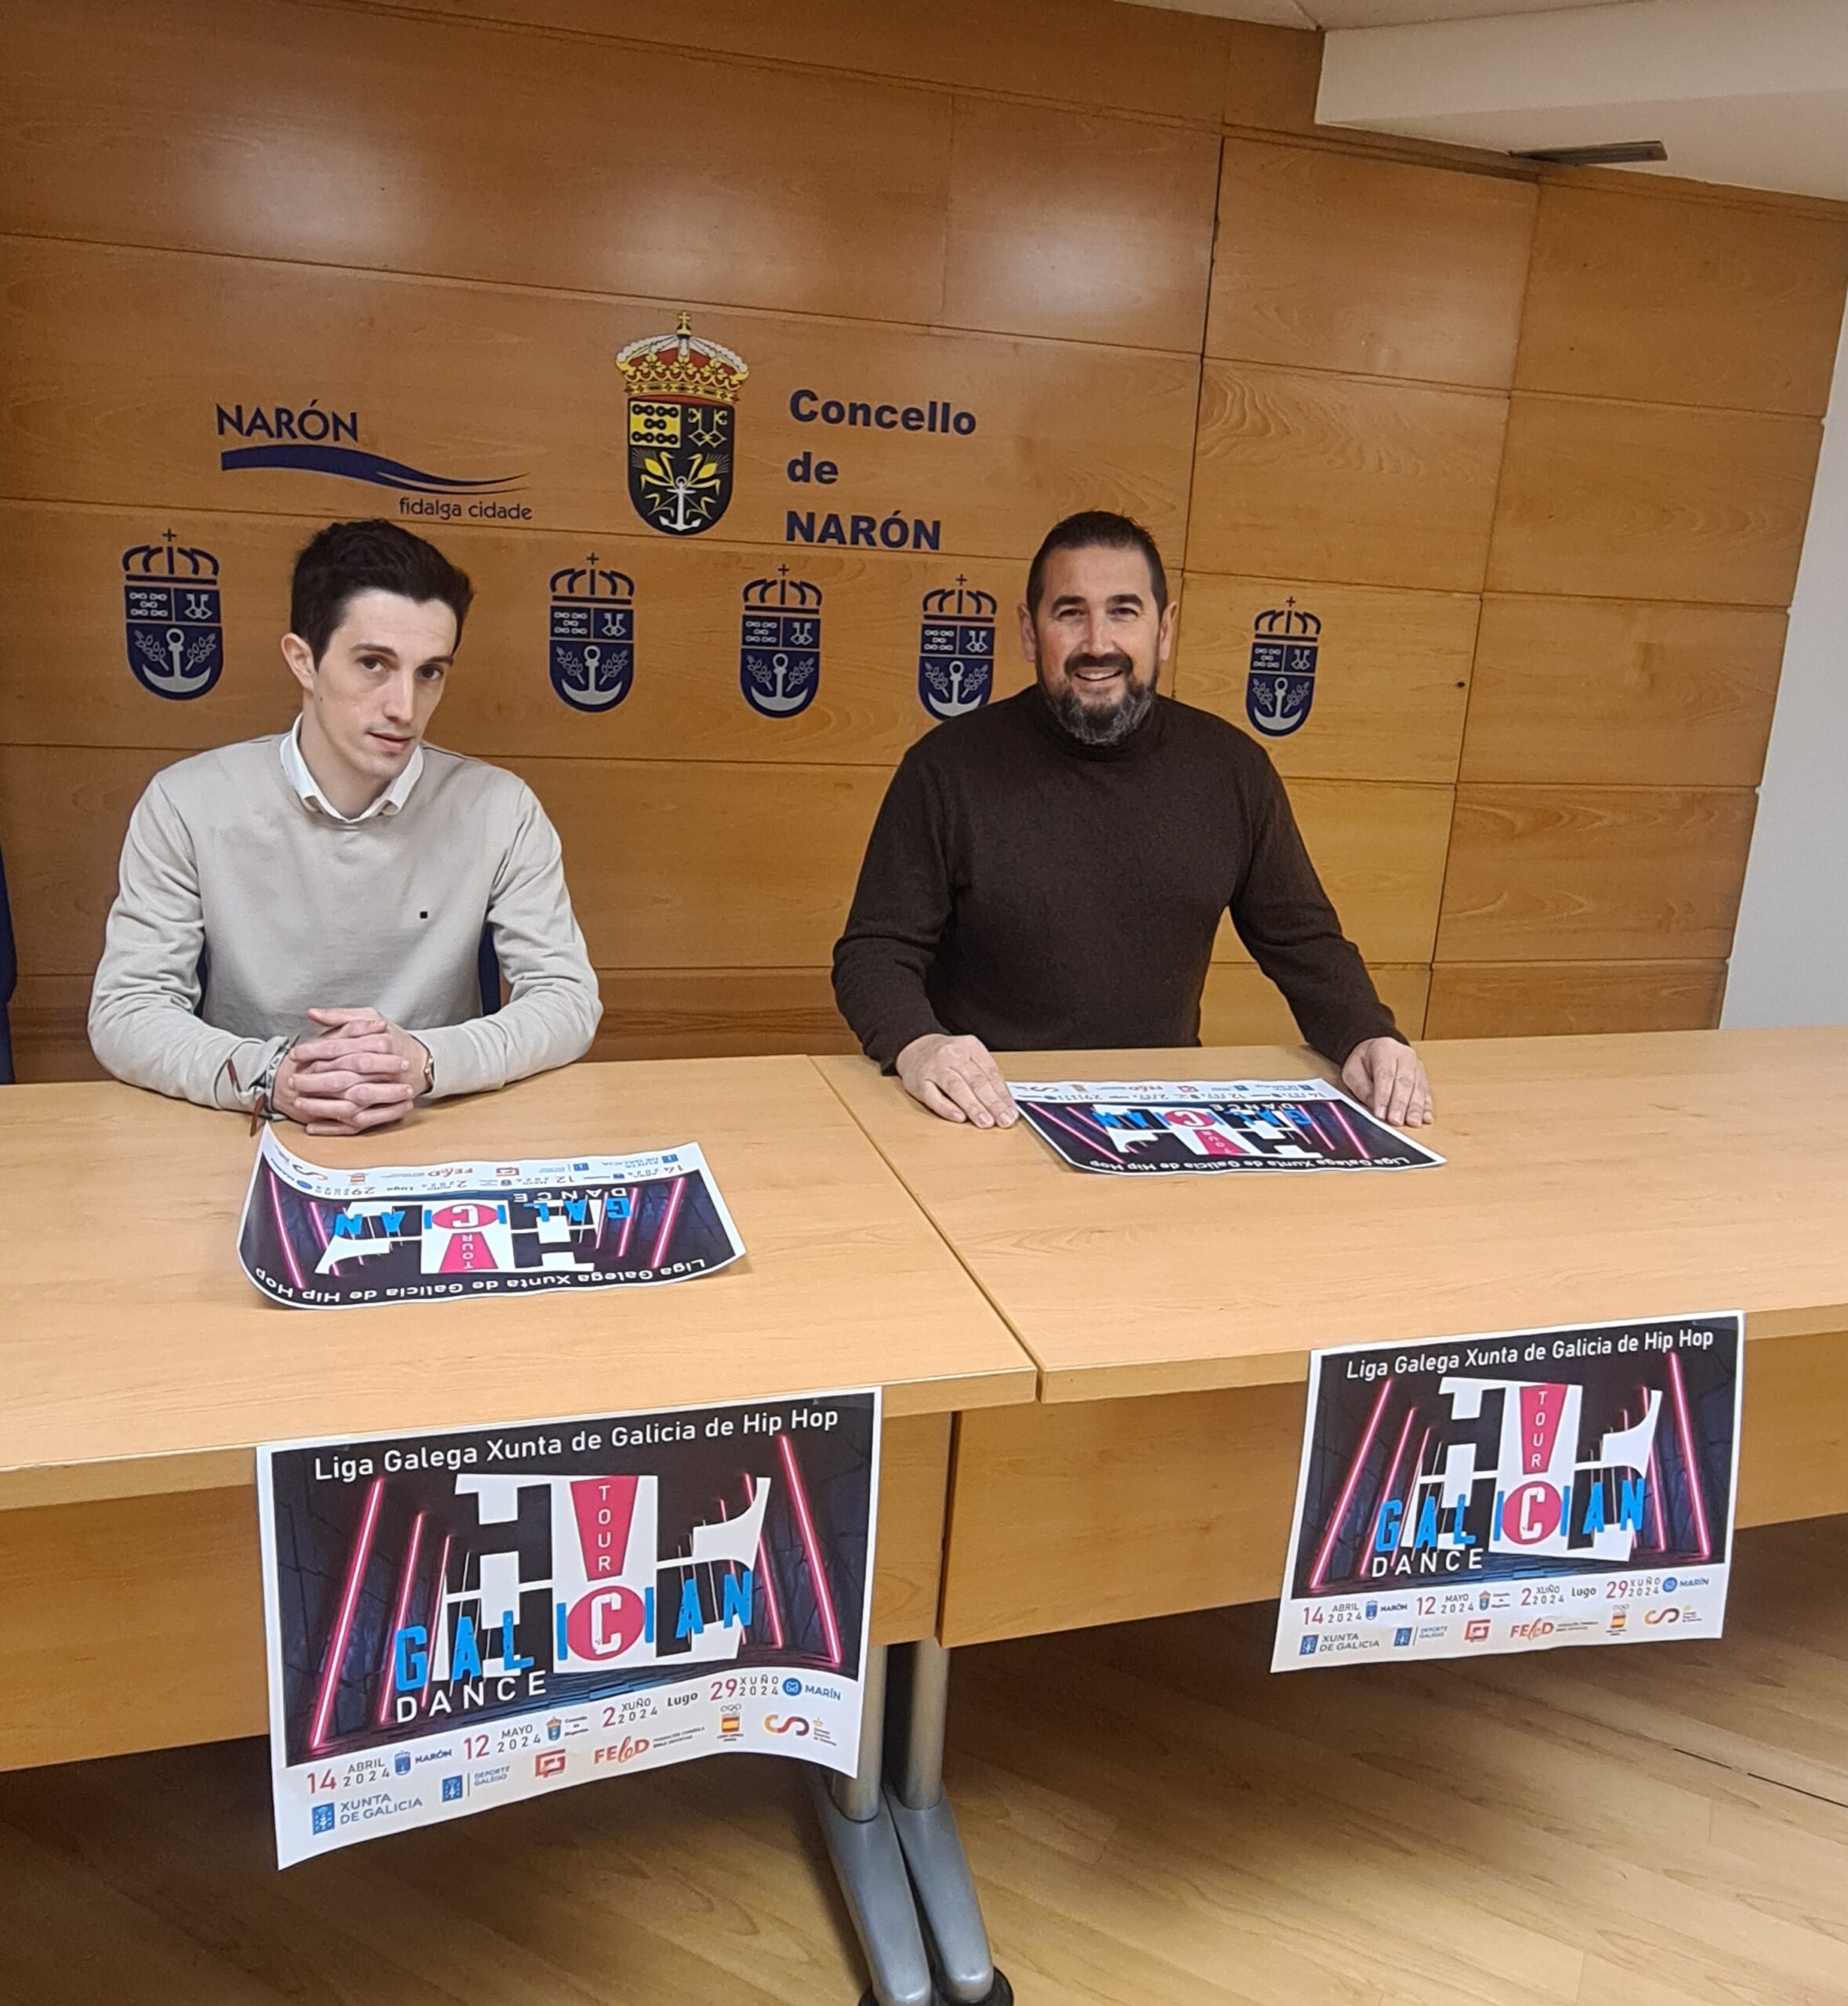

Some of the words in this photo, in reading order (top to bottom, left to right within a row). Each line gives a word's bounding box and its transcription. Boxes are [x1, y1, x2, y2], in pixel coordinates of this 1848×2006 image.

[216, 399, 358, 443] NARÓN
[790, 389, 977, 436] Concello
[786, 451, 839, 484] de
[399, 497, 462, 520] fidalga
[468, 500, 533, 520] cidade
[785, 510, 941, 551] NARÓN
[1089, 1160, 1125, 1171] Hop
[1127, 1161, 1157, 1171] Hip
[1183, 1160, 1241, 1169] Galicia
[1267, 1159, 1316, 1168] Xunta
[1316, 1158, 1372, 1168] Galega
[1373, 1157, 1411, 1166] Liga
[513, 1186, 627, 1203] DANCE
[462, 1233, 474, 1269] TOUR
[660, 1258, 705, 1276] Liga
[255, 1267, 293, 1298] Hop
[472, 1279, 498, 1290] de
[507, 1275, 571, 1288] Xunta
[578, 1270, 654, 1283] Galega
[302, 1291, 340, 1302] Hip
[350, 1290, 377, 1301] de
[386, 1282, 463, 1298] Galicia
[1346, 1360, 1388, 1381] Liga
[1394, 1355, 1459, 1377] Galega
[1465, 1348, 1517, 1367] Xunta
[1524, 1343, 1545, 1362] de
[1552, 1332, 1612, 1360] Galicia
[1618, 1331, 1639, 1352] de
[1645, 1331, 1673, 1354] Hip
[1679, 1329, 1713, 1351] Hop
[1531, 1390, 1548, 1468] TOUR
[315, 1455, 373, 1483] Liga
[384, 1447, 477, 1472] Galega
[486, 1436, 562, 1461] Xunta
[571, 1431, 603, 1452] de
[611, 1421, 696, 1447] Galicia
[705, 1417, 734, 1438] de
[742, 1411, 782, 1436] Hip
[791, 1408, 839, 1431] Hop
[1375, 1478, 1644, 1552] GALICIAN
[597, 1484, 612, 1572] TOUR
[1372, 1548, 1484, 1578] DANCE
[1520, 1588, 1531, 1606] 2
[1571, 1586, 1596, 1599] Lugo
[1606, 1580, 1628, 1599] 29
[1628, 1586, 1659, 1597] 2024
[1416, 1595, 1437, 1616] 12
[1444, 1593, 1469, 1602] MAYO
[1440, 1602, 1474, 1614] 2024
[1533, 1595, 1564, 1606] 2024
[1303, 1606, 1323, 1625] 14
[1332, 1602, 1360, 1613] ABRIL
[1328, 1612, 1362, 1624] 2024
[394, 1570, 753, 1693] GALICIAN
[1322, 1632, 1360, 1642] XUNTA
[1319, 1643, 1334, 1653] DE
[1335, 1639, 1380, 1651] GALICIA
[710, 1678, 737, 1701] 29
[739, 1674, 779, 1686] XUÑO
[739, 1686, 779, 1696] 2024
[805, 1685, 841, 1701] MARÍN
[395, 1670, 547, 1724] DANCE
[667, 1692, 698, 1707] Lugo
[602, 1707, 616, 1728] 2
[621, 1697, 651, 1711] XUÑO
[618, 1707, 658, 1725] 2024
[463, 1734, 491, 1761] 12
[502, 1724, 534, 1740] MAYO
[498, 1734, 541, 1754] 2024
[415, 1748, 452, 1764] NARÓN
[306, 1769, 337, 1794] 14
[347, 1758, 386, 1775] ABRIL
[343, 1769, 390, 1788] 2024
[474, 1773, 508, 1787] GALEGO
[340, 1793, 392, 1812] XUNTA
[340, 1811, 360, 1825] DE
[364, 1798, 423, 1820] GALICIA
